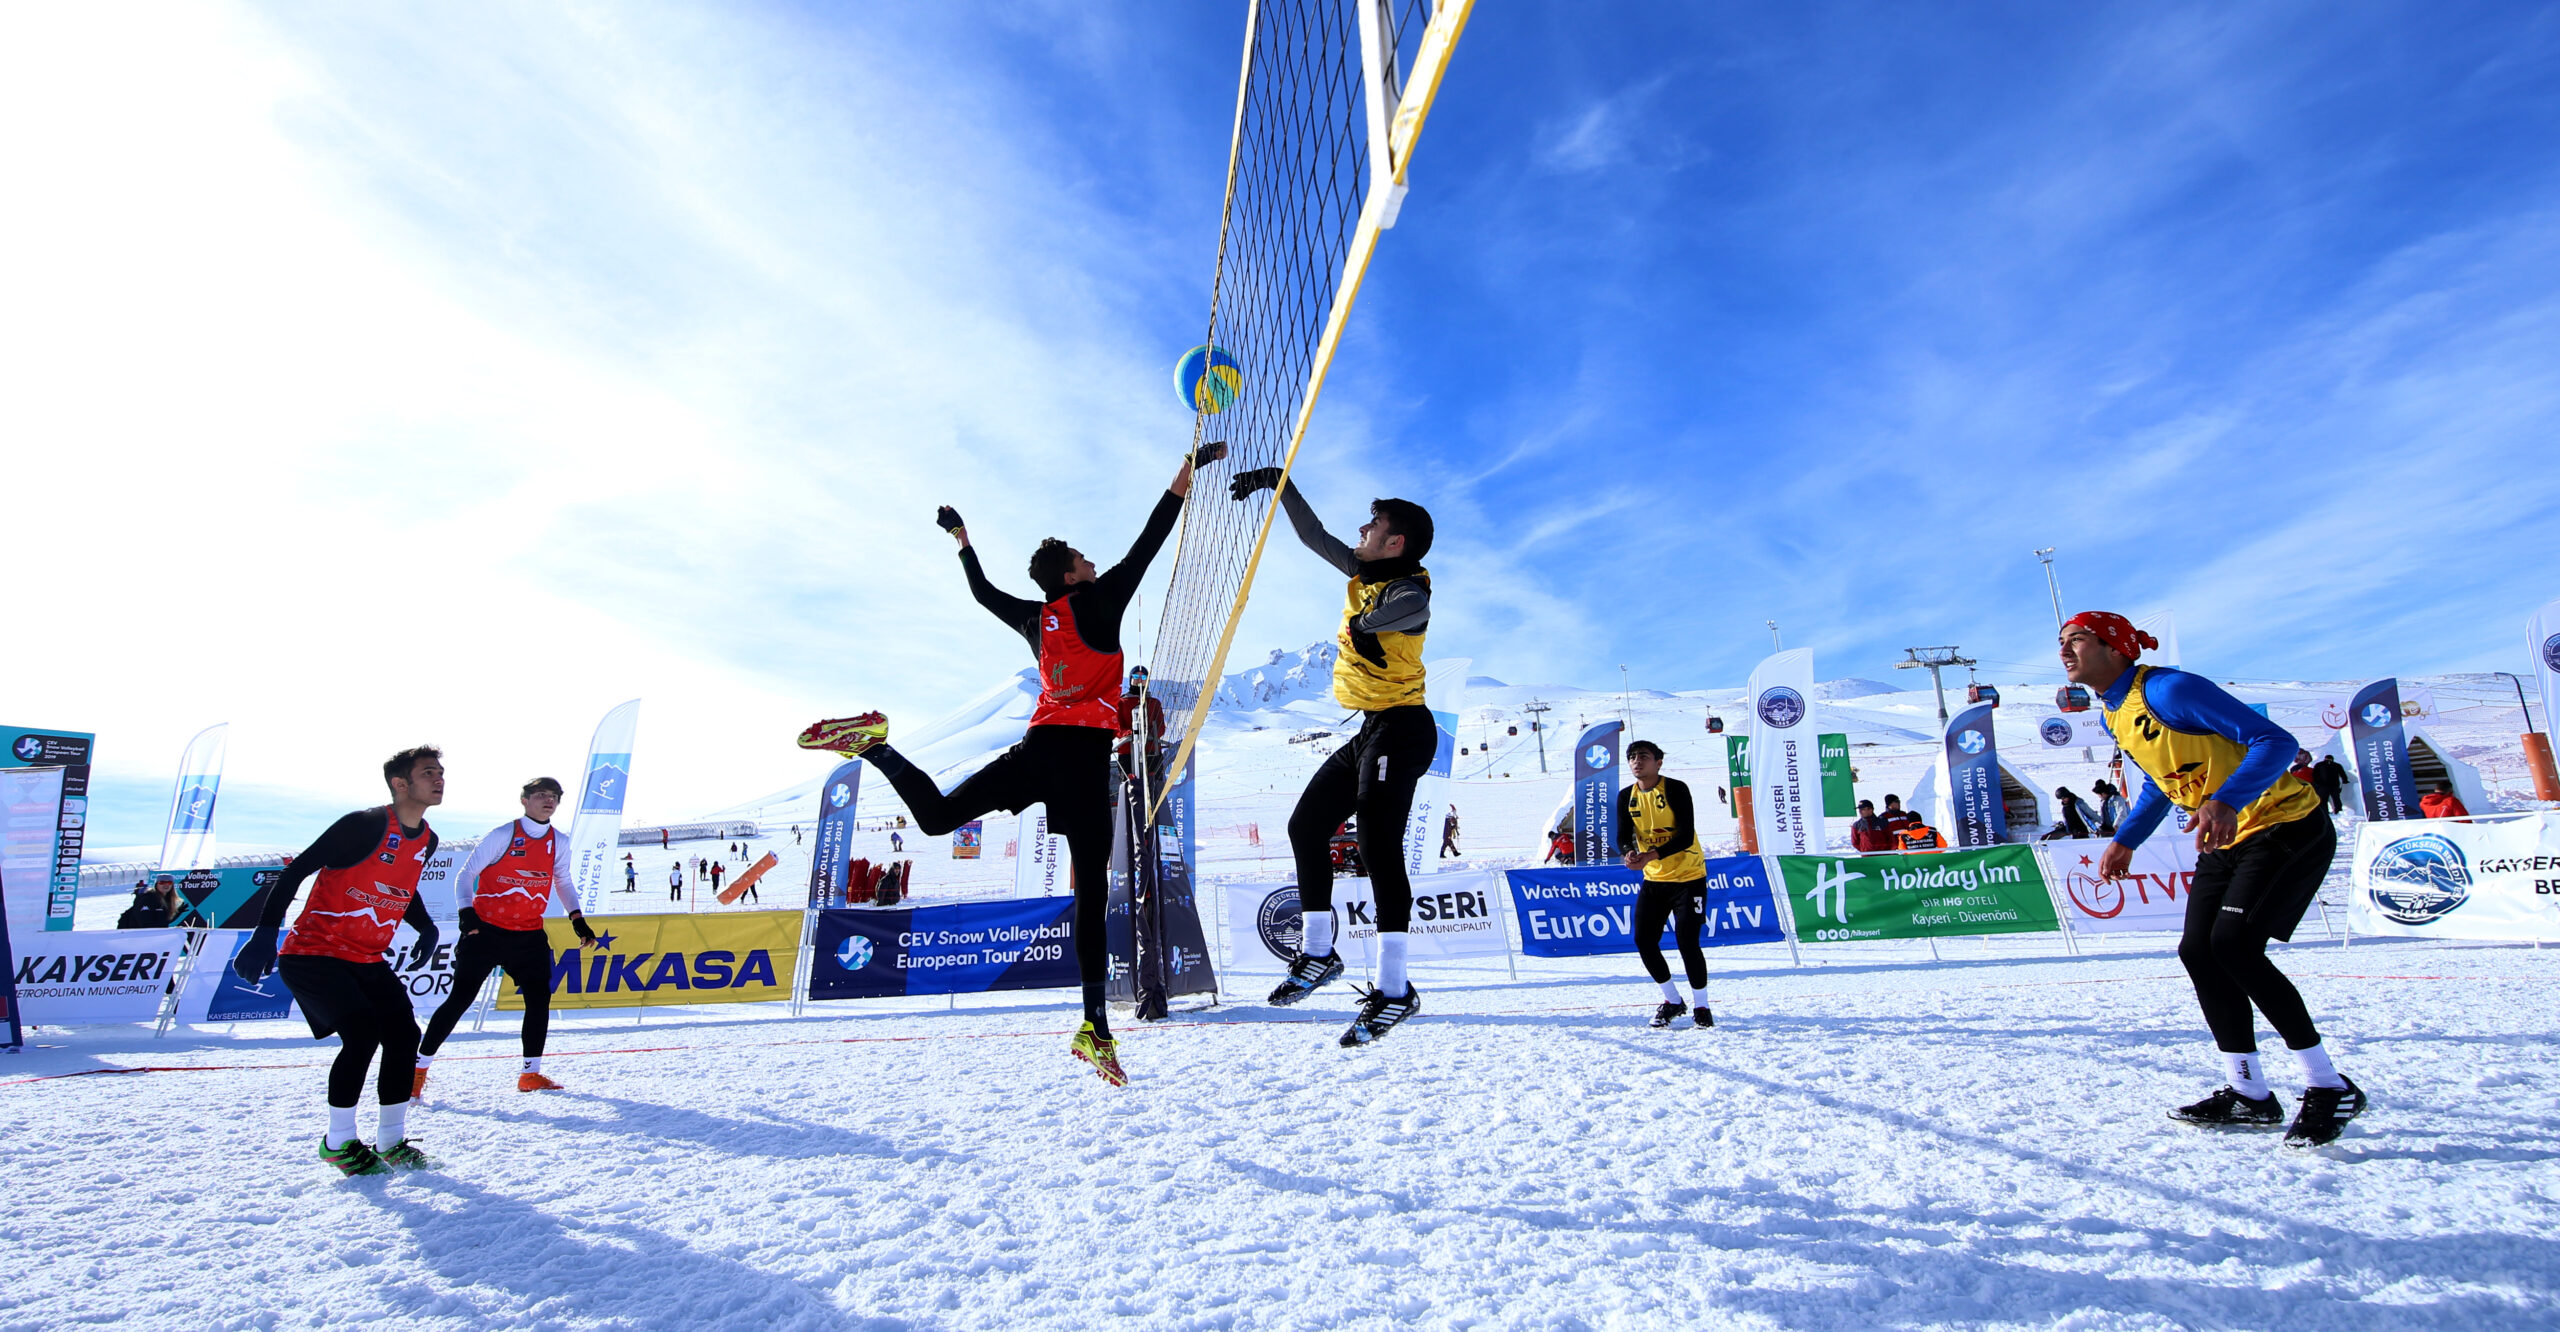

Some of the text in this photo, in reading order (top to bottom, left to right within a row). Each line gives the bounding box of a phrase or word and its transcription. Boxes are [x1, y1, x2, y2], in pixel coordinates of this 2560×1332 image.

[1045, 615, 1059, 632] 3
[2134, 713, 2161, 742] 2
[1821, 743, 1845, 759] Inn
[2382, 740, 2394, 762] 2019
[1377, 755, 1388, 782] 1
[1783, 740, 1801, 803] BELEDİYESİ
[1976, 766, 1987, 789] 2019
[2368, 740, 2385, 802] VOLLEYBALL
[2388, 768, 2398, 784] Tour
[1598, 781, 1608, 804] 2019
[1656, 794, 1666, 810] 3
[1962, 767, 1977, 826] VOLLEYBALL
[1981, 790, 1990, 810] Tour
[1175, 797, 1185, 819] 2019
[1600, 804, 1608, 825] Tour
[1771, 785, 1788, 833] KAYSERİ
[1585, 781, 1595, 867] NOW VOLLEYBALL
[546, 839, 553, 855] 1
[819, 820, 834, 879] VOLLEYBALL
[1034, 815, 1047, 863] KAYSERİ
[1409, 825, 1427, 876] ERCİYES
[577, 849, 592, 900] KAYSERİ
[826, 820, 844, 907] European Tour 2019
[1880, 865, 1978, 891] Holiday
[1978, 859, 2021, 884] Inn
[187, 872, 222, 881] Volleyball
[200, 880, 218, 888] 2019
[421, 870, 446, 881] 2019
[1521, 882, 1582, 900] Watch
[1734, 874, 1755, 888] on
[584, 864, 602, 914] ERCİYES
[816, 882, 827, 912] SNOW
[1693, 896, 1703, 914] 3
[1921, 895, 1998, 908] BİR IHG OTELİ
[1427, 921, 1492, 934] MUNICIPALITY
[1912, 912, 1951, 927] Kayseri
[1959, 909, 2018, 924] Düvenönü
[898, 921, 1071, 948] CEV Snow Volleyball
[896, 944, 1063, 971] European Tour 2019
[88, 984, 160, 997] MUNICIPALITY
[208, 1011, 240, 1020] KAYSERİ
[240, 1010, 272, 1020] ERCİYES
